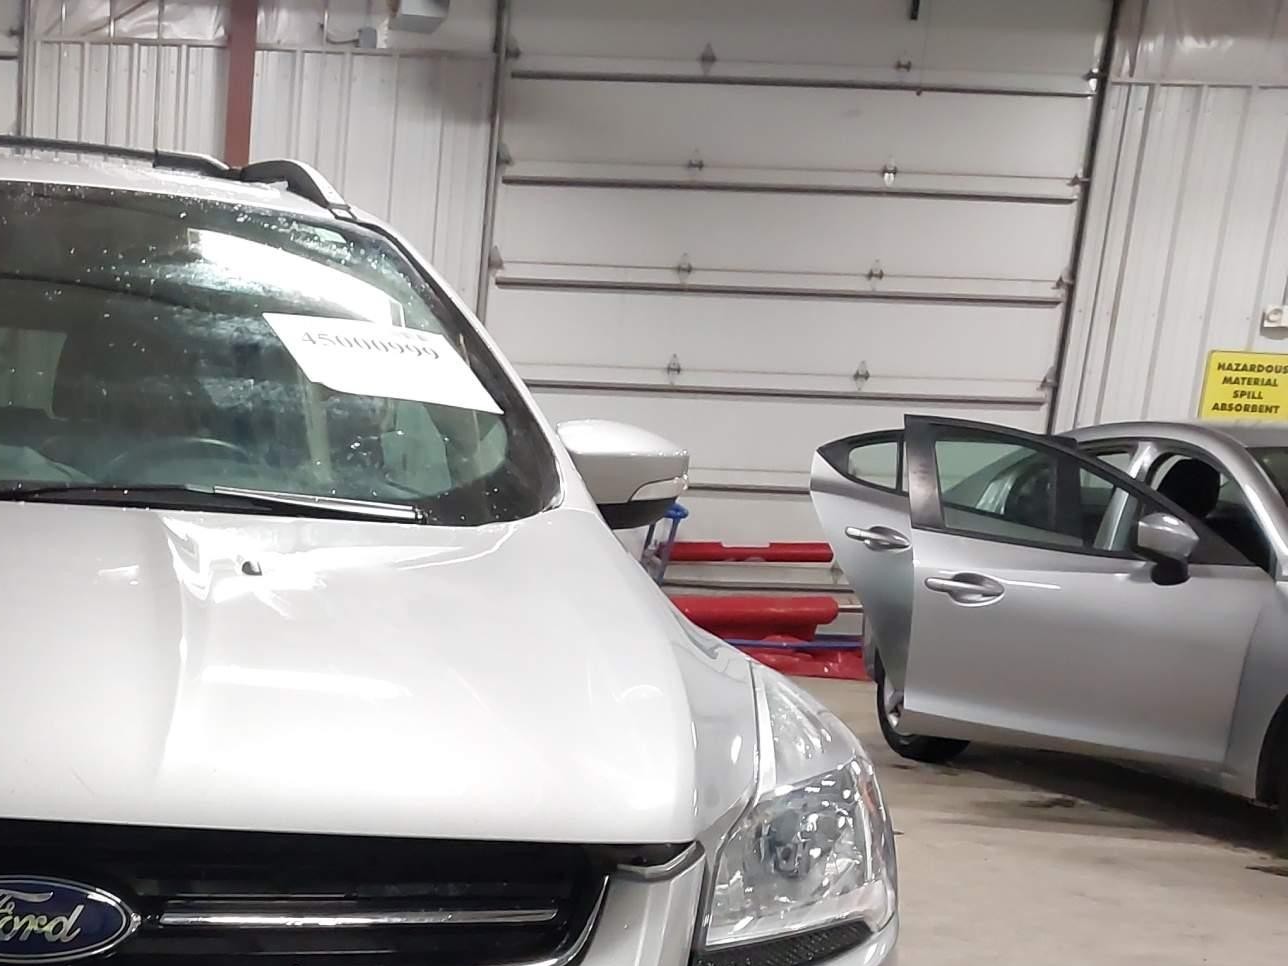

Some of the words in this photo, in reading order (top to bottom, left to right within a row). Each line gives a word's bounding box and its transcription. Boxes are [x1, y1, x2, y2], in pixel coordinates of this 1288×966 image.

[302, 331, 441, 360] 45000999
[1217, 362, 1288, 374] HAZARDOUS
[1222, 376, 1279, 387] MATERIAL
[1232, 390, 1264, 400] SPILL
[1211, 402, 1281, 414] ABSORBENT
